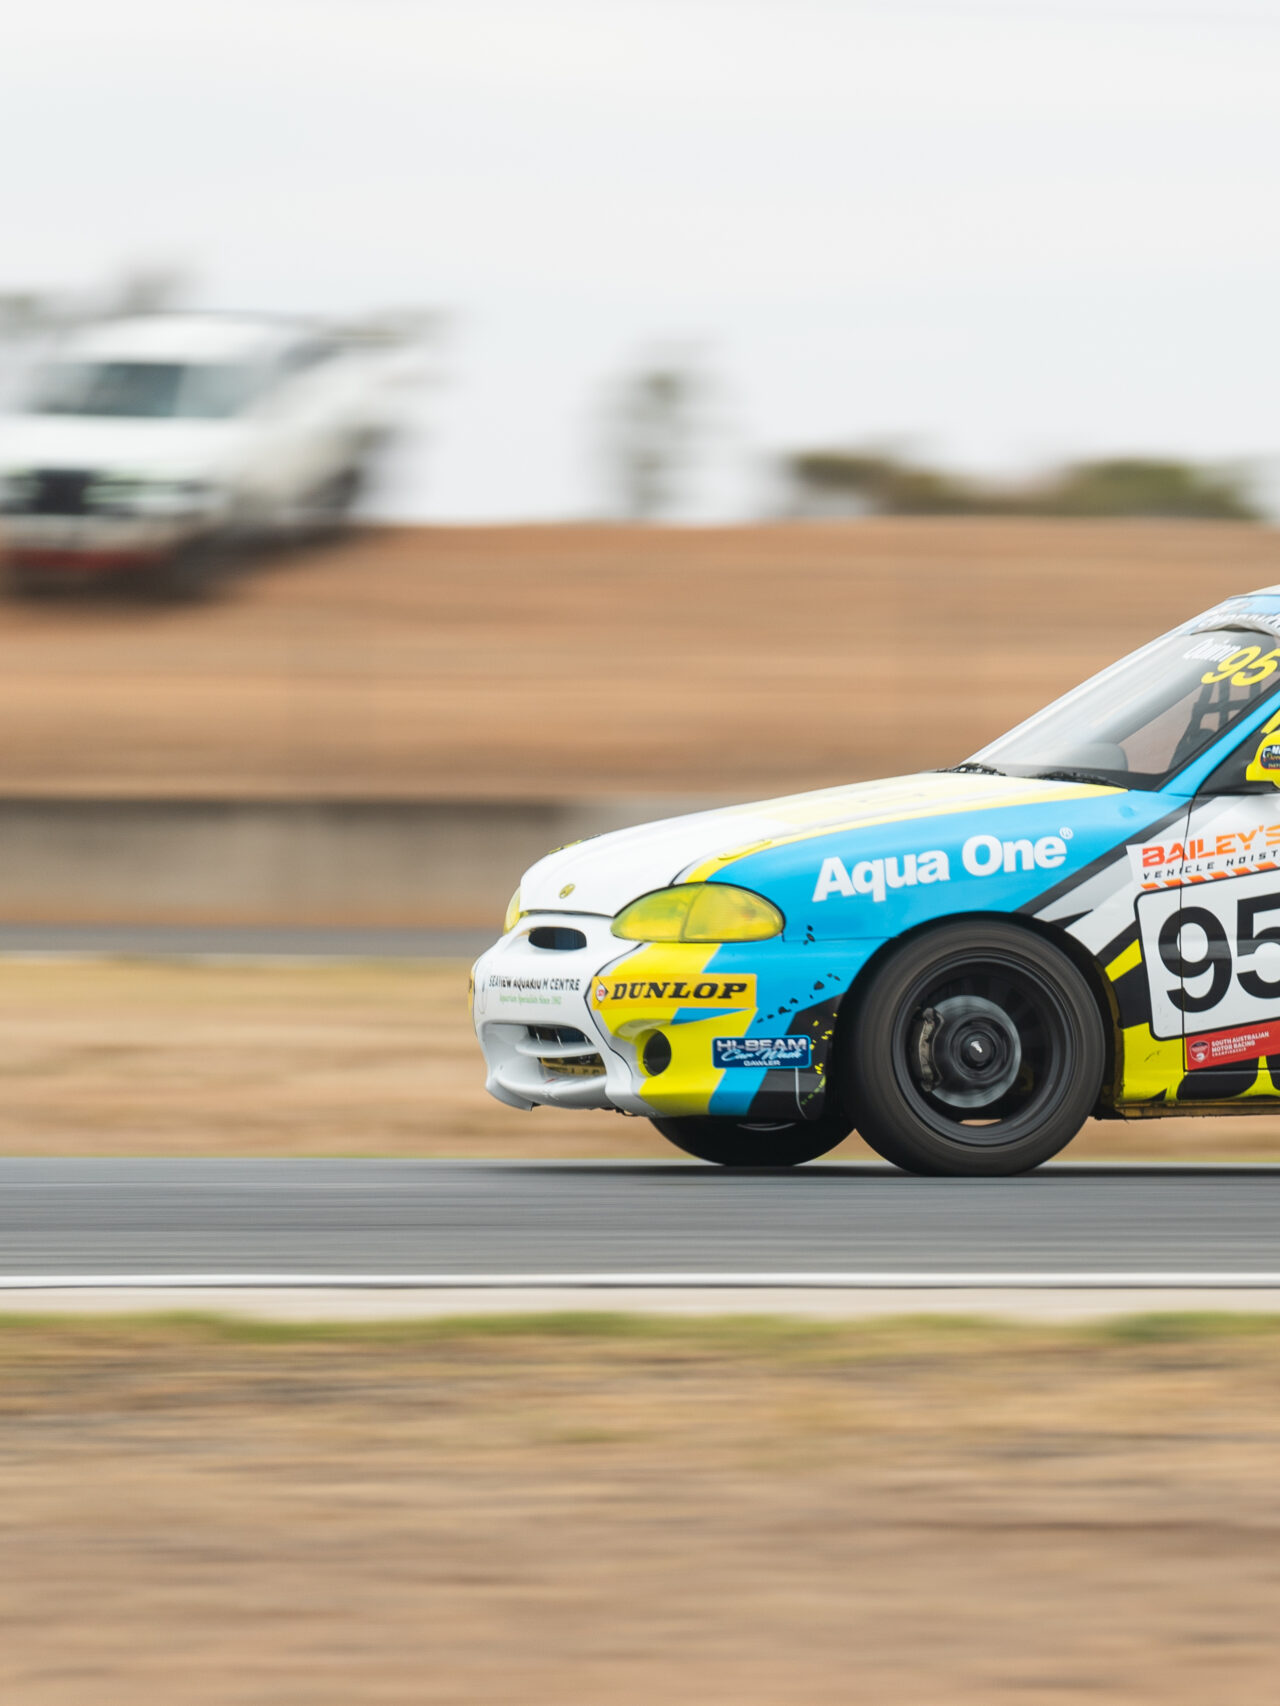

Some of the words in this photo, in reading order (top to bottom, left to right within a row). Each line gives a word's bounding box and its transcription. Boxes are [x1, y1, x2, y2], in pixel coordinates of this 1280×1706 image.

[811, 849, 950, 903] Aqua
[1143, 861, 1215, 880] VEHICLE
[550, 978, 580, 991] CENTRE
[610, 981, 748, 1000] DUNLOP
[716, 1038, 807, 1052] HI-BEAM
[1211, 1038, 1232, 1047] SOUTH
[1232, 1031, 1269, 1043] AUSTRALIAN
[1211, 1043, 1233, 1053] MOTOR
[1233, 1040, 1256, 1049] RACING
